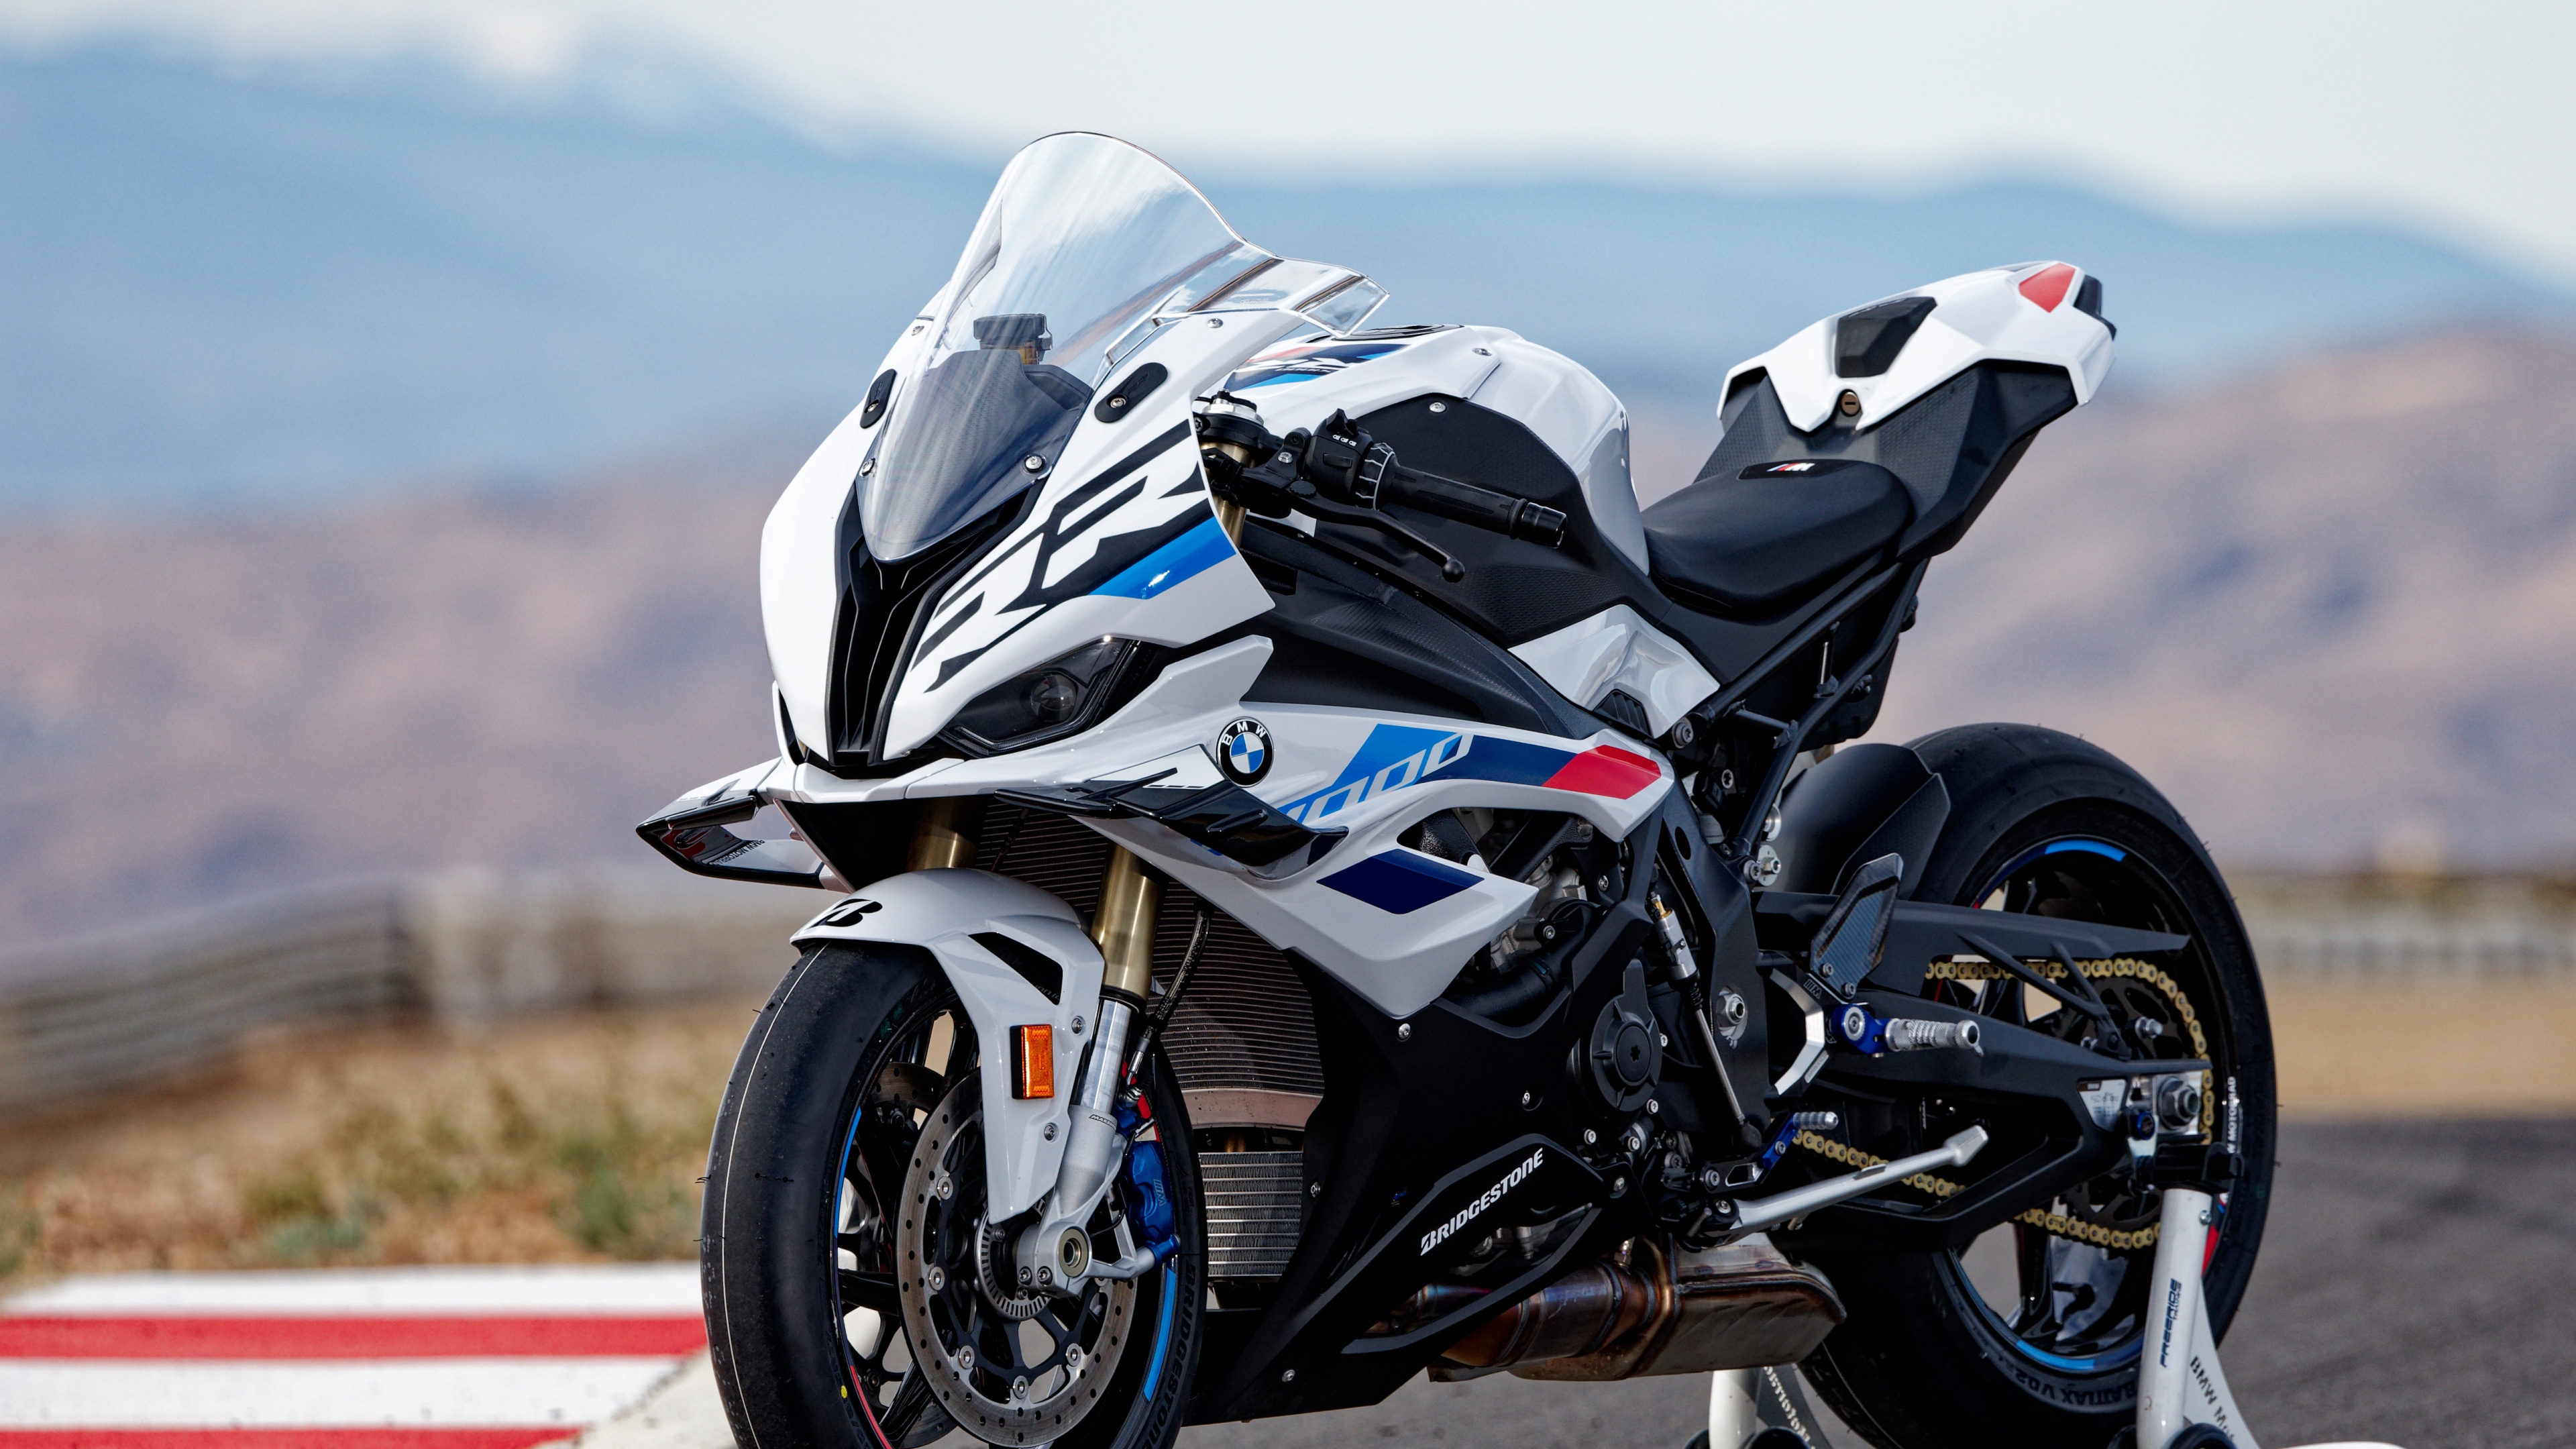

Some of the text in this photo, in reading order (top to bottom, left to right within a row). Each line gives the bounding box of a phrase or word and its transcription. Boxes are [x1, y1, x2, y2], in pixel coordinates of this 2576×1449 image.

[1222, 720, 1267, 746] BMW
[747, 840, 766, 851] BMW
[1420, 1147, 1543, 1256] BRIDGESTONE
[2159, 1278, 2178, 1368] FREERIDE
[2059, 1379, 2137, 1407] BATTLAX
[2189, 1355, 2218, 1406] BMW
